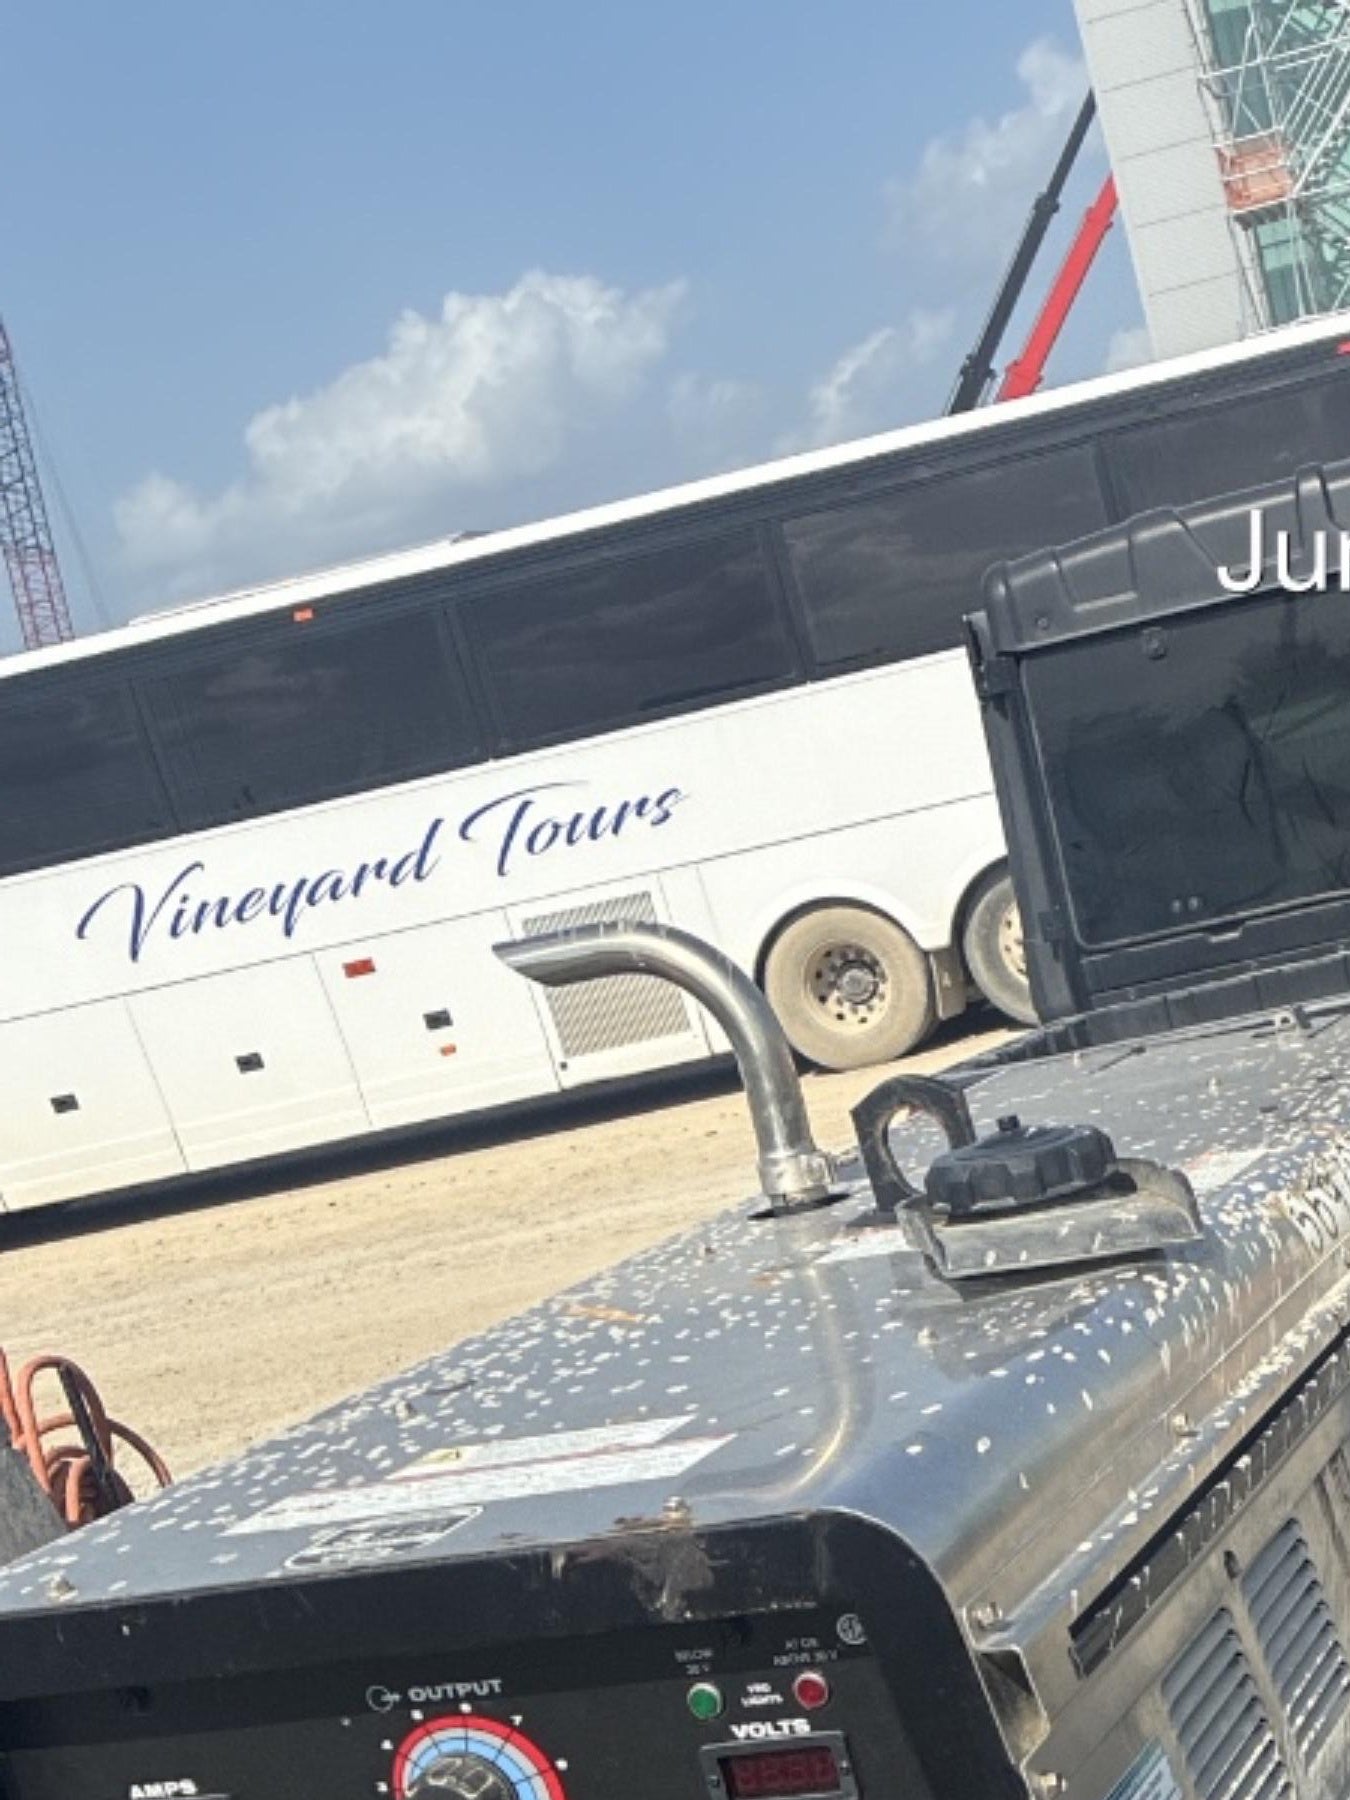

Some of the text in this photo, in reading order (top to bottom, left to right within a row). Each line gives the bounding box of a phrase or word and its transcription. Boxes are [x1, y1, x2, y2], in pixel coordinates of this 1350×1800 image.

[76, 780, 692, 963] Vineyard Tours
[407, 1678, 503, 1702] OUTPUT
[729, 1717, 812, 1741] VOLTS
[129, 1778, 197, 1800] AMPS
